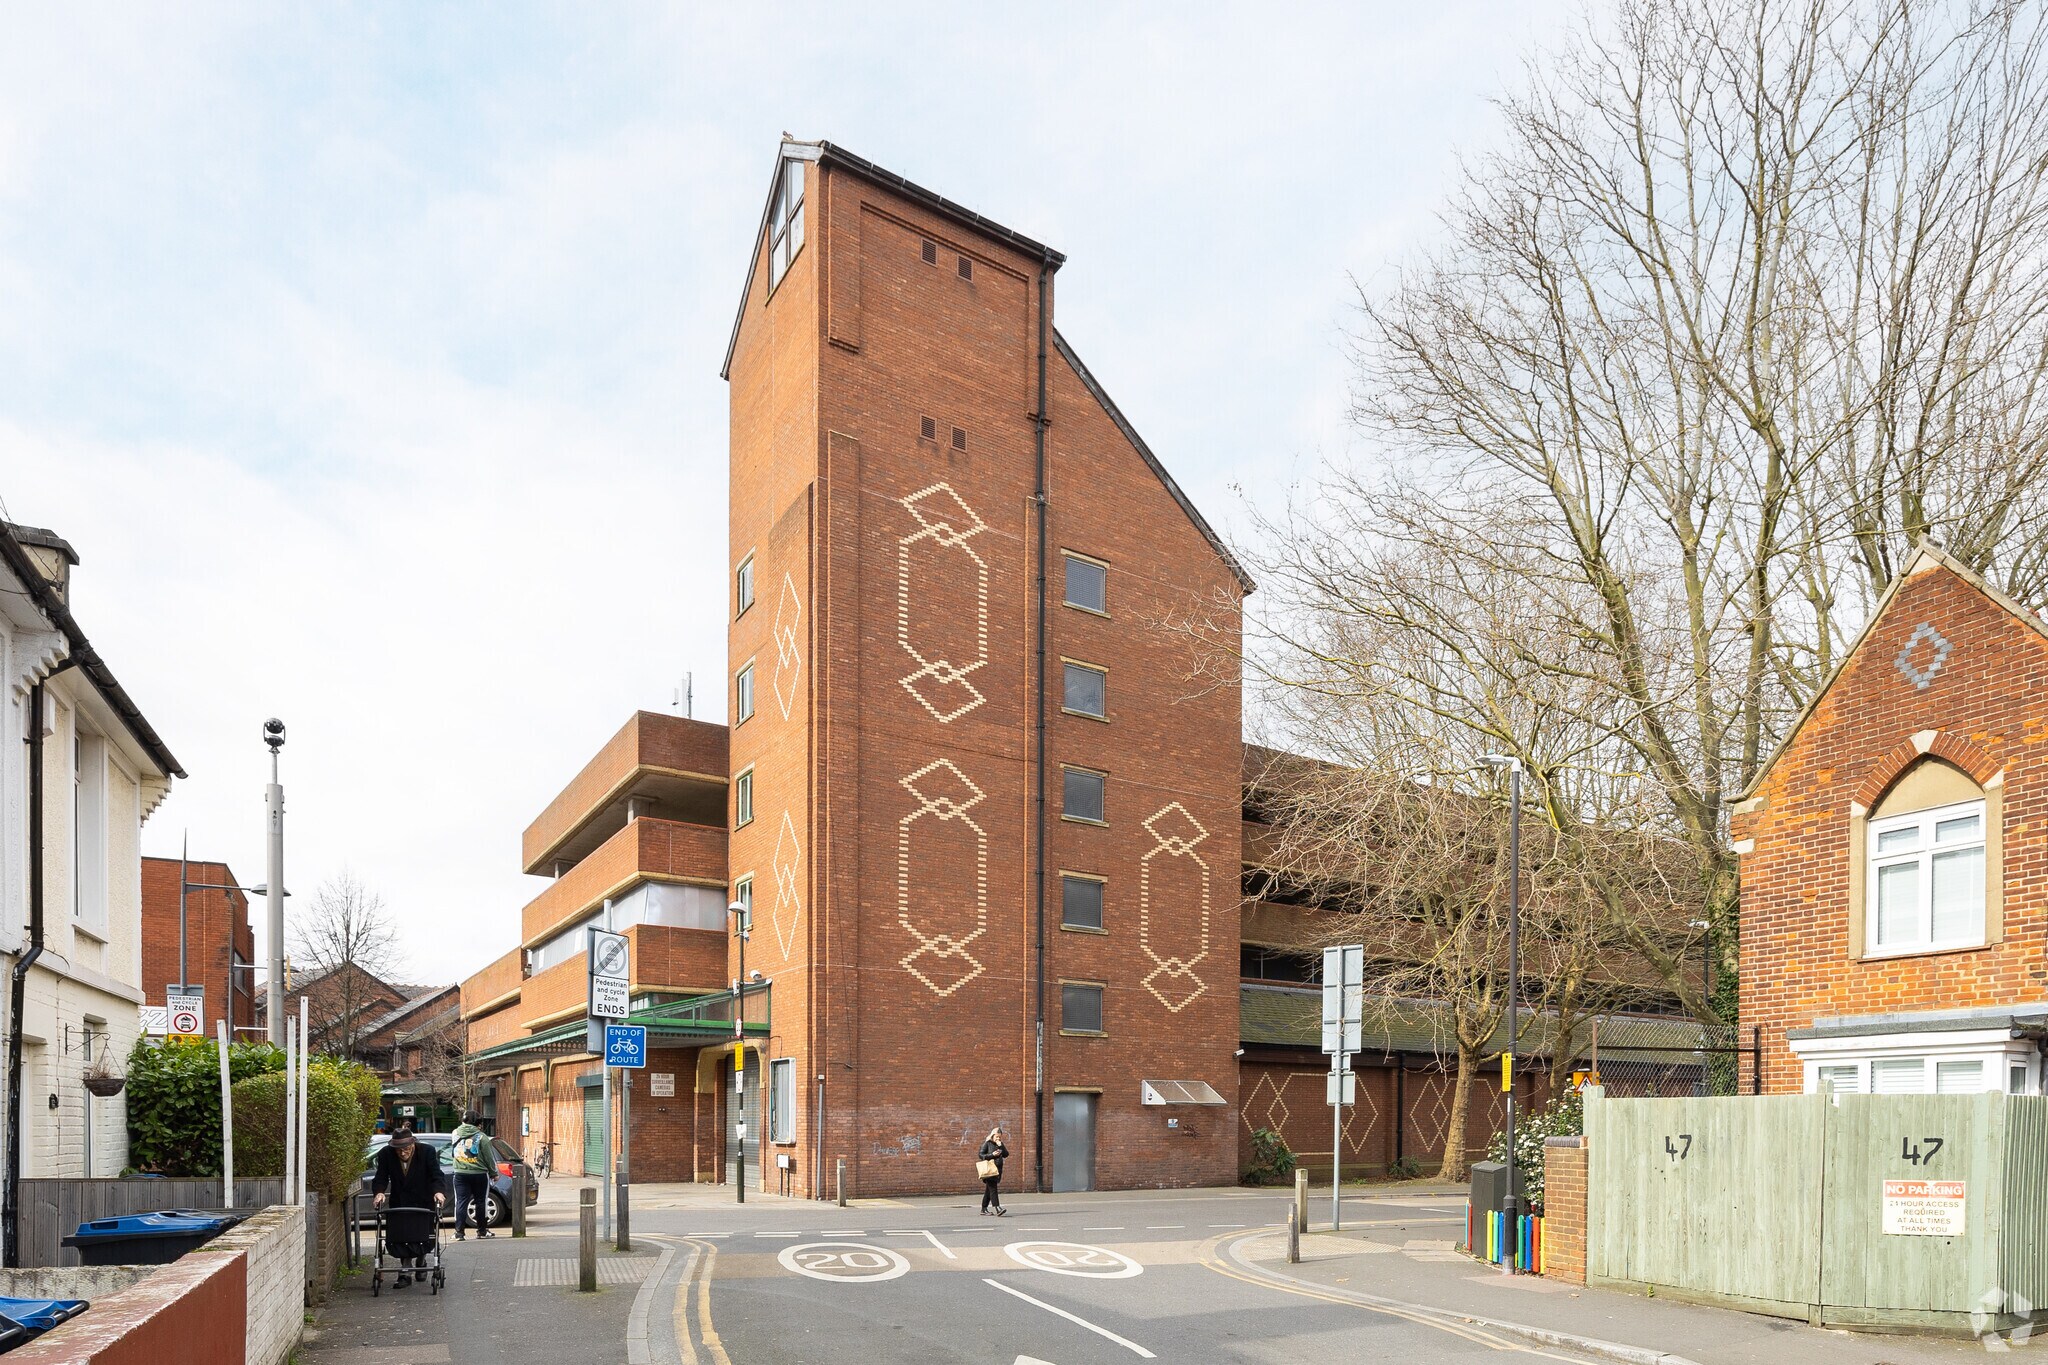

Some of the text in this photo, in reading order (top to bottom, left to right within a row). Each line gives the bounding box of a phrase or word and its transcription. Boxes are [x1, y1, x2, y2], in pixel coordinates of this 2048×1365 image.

[596, 978, 627, 988] Pedestrian
[598, 1004, 625, 1014] ENDS
[1666, 1134, 1692, 1162] 47
[1902, 1137, 1944, 1166] 47
[1886, 1185, 1962, 1195] NO PARKING
[796, 1252, 890, 1270] 20
[1025, 1250, 1118, 1267] 20
